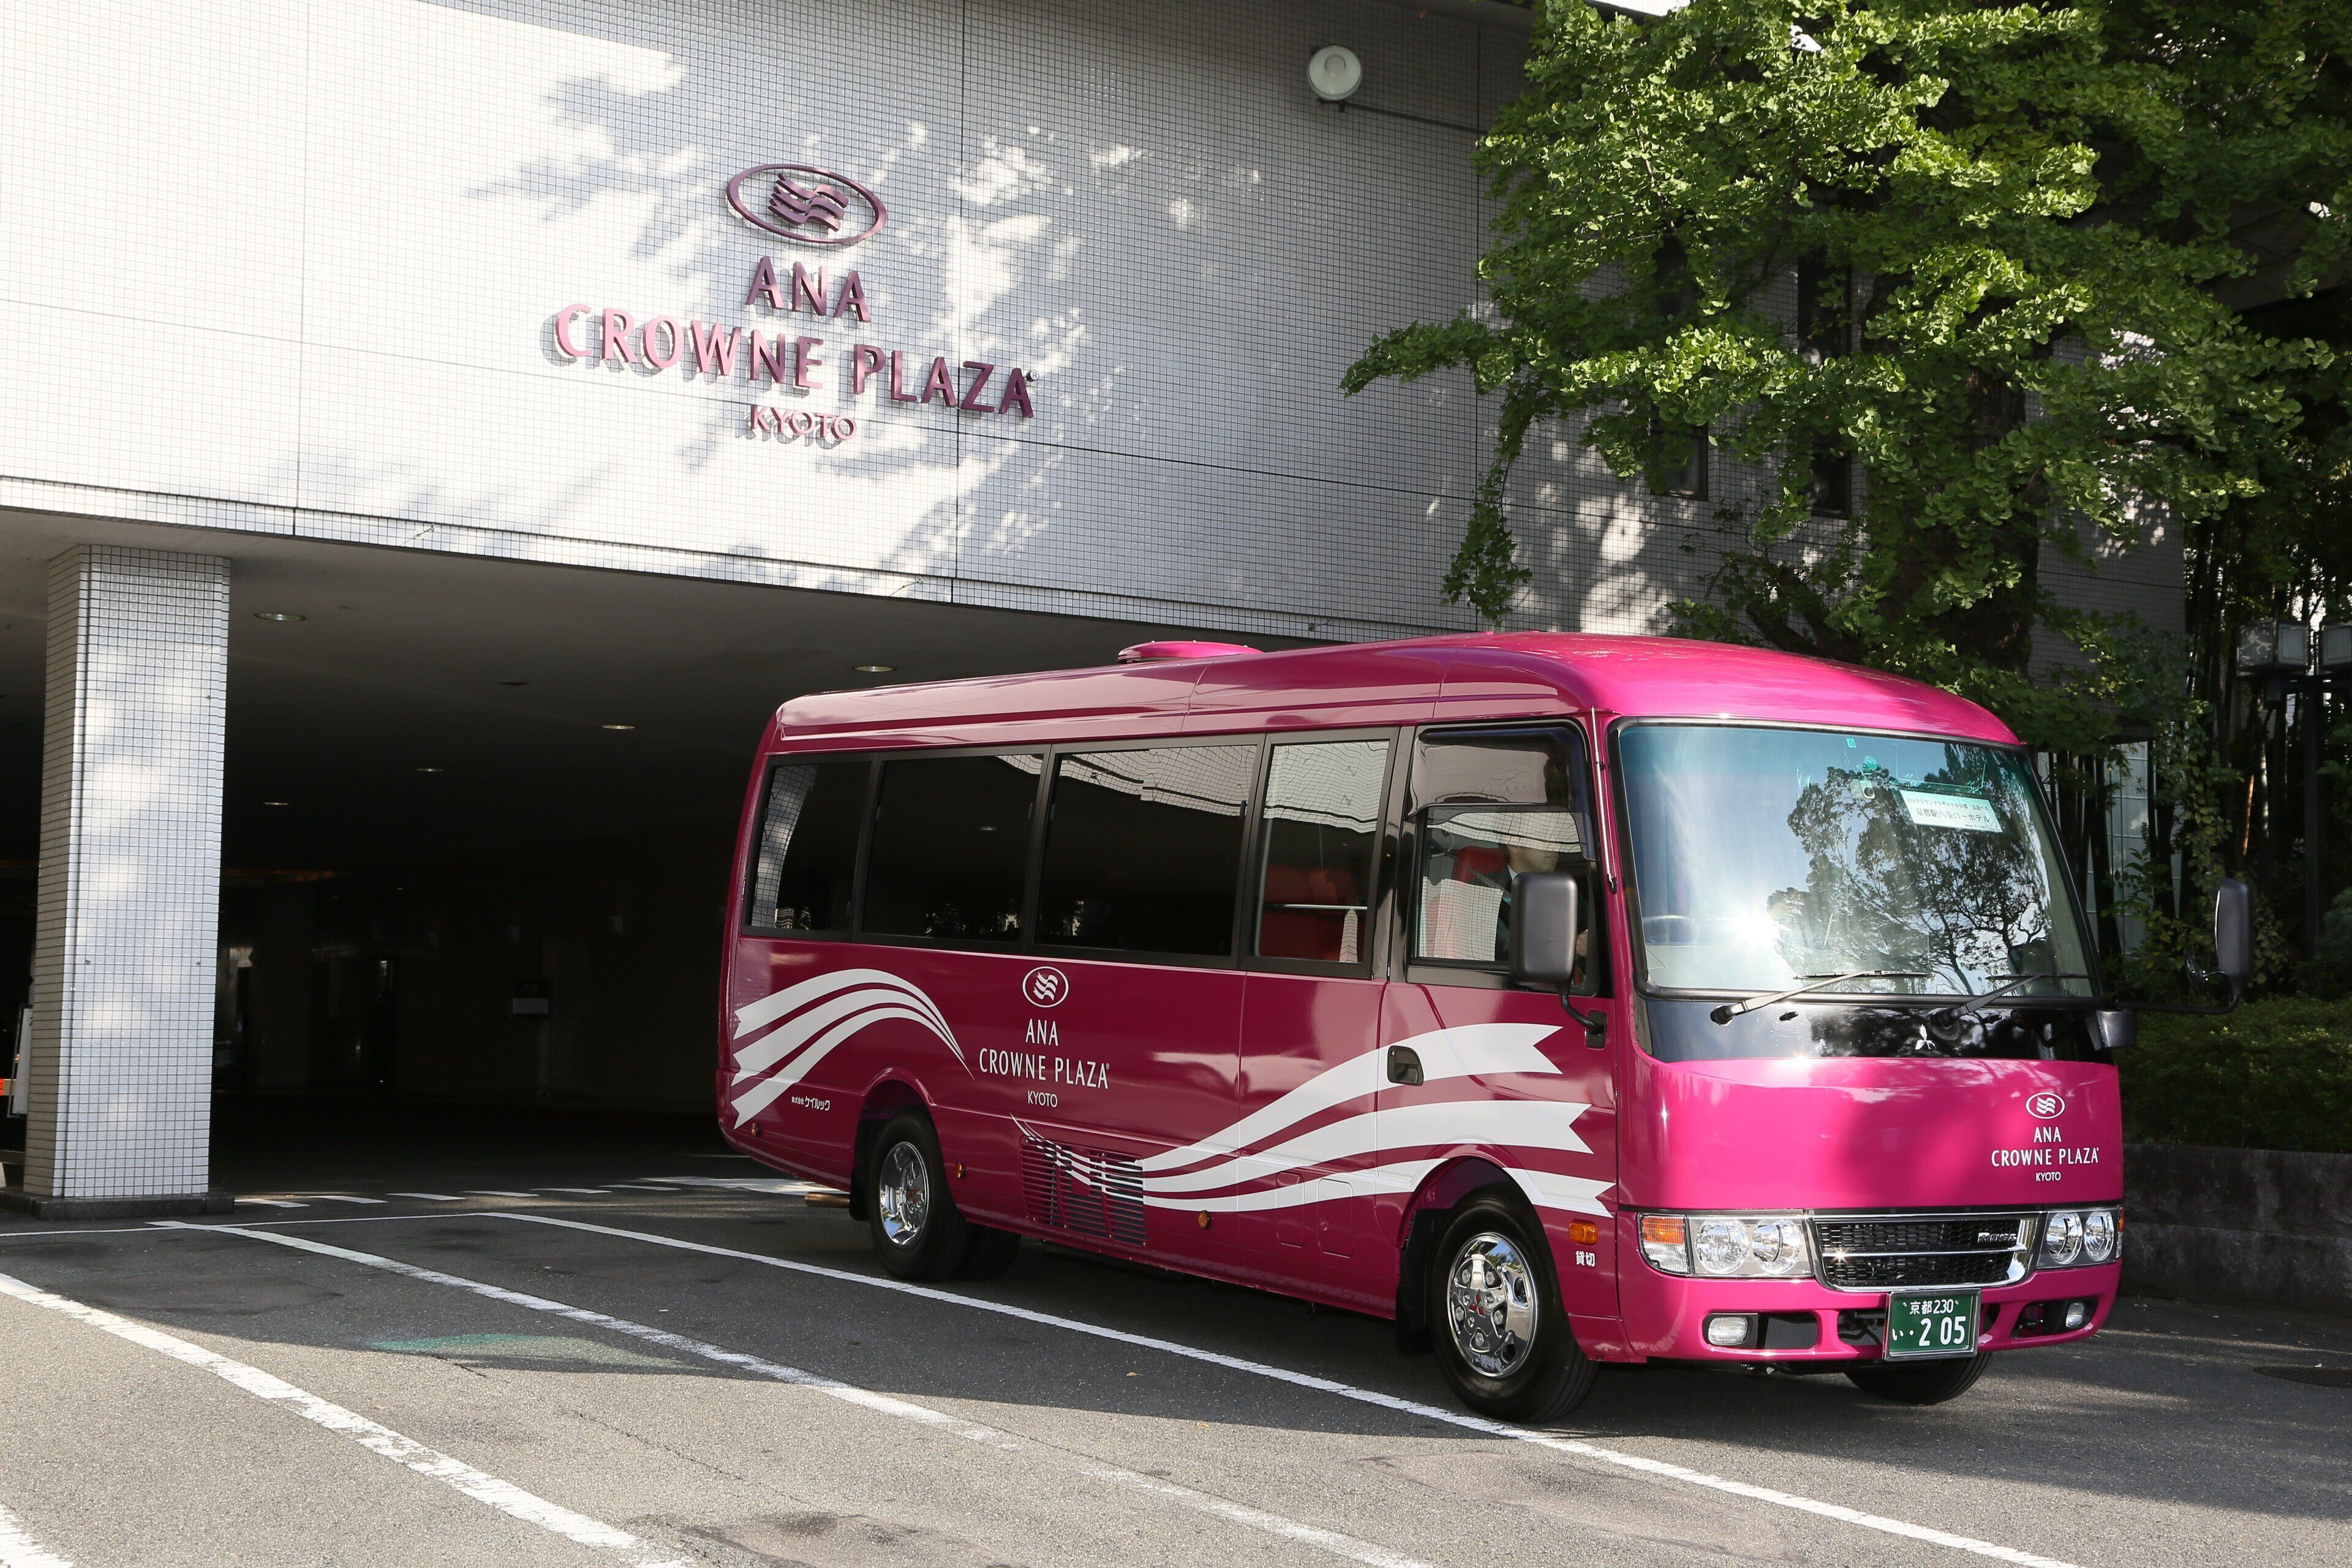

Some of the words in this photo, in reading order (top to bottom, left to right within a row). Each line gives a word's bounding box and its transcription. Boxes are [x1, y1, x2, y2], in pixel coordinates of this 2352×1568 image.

[745, 255, 872, 323] ANA
[555, 303, 824, 390] CROWNE
[750, 404, 858, 442] KYOTO
[1025, 1018, 1058, 1046] ANA
[979, 1047, 1047, 1081] CROWNE
[1027, 1090, 1058, 1108] KYOTO
[2033, 1126, 2062, 1144] ANA
[1991, 1149, 2052, 1167] CROWNE
[2035, 1171, 2062, 1182] KYOTO
